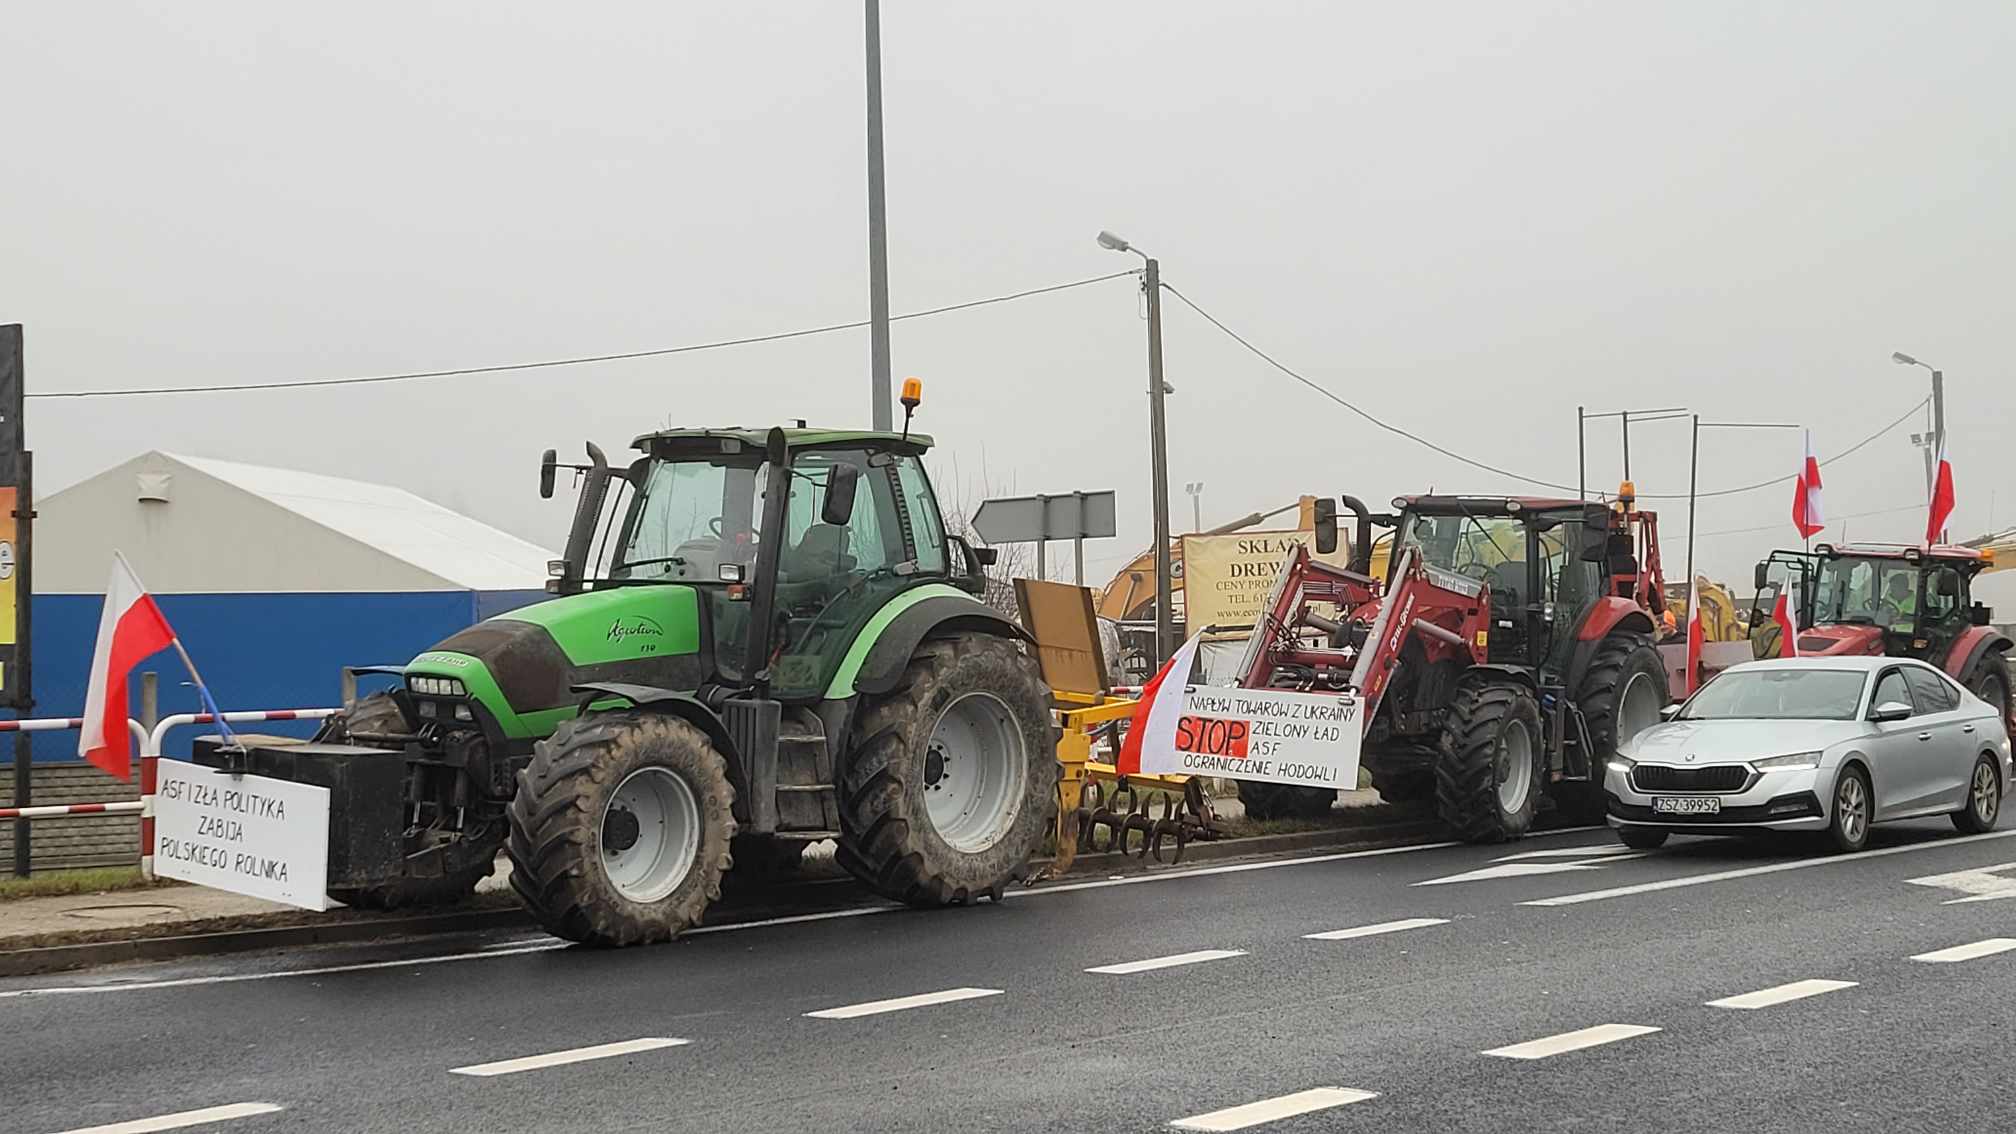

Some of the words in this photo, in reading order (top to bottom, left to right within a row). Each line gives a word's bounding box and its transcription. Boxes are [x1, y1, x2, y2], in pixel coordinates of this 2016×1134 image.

[1215, 580, 1247, 591] CENY
[1189, 696, 1231, 712] NAPŁYW
[1291, 703, 1302, 719] Z
[1303, 705, 1356, 722] UKRAINY
[1178, 716, 1246, 756] STOP
[1252, 720, 1310, 739] ZIELONY
[1313, 726, 1340, 742] ŁAD
[1250, 741, 1281, 756] ASF
[1183, 754, 1272, 776] OGRANICZENIE
[160, 779, 186, 801] ASF
[187, 783, 192, 802] I
[194, 784, 219, 808] ZŁA
[223, 790, 286, 821] POLITYKA
[1658, 798, 1680, 811] ZSZ
[1682, 799, 1719, 812] 39952
[197, 815, 244, 842] ZABIJA
[160, 836, 228, 869] POLSKIEGO
